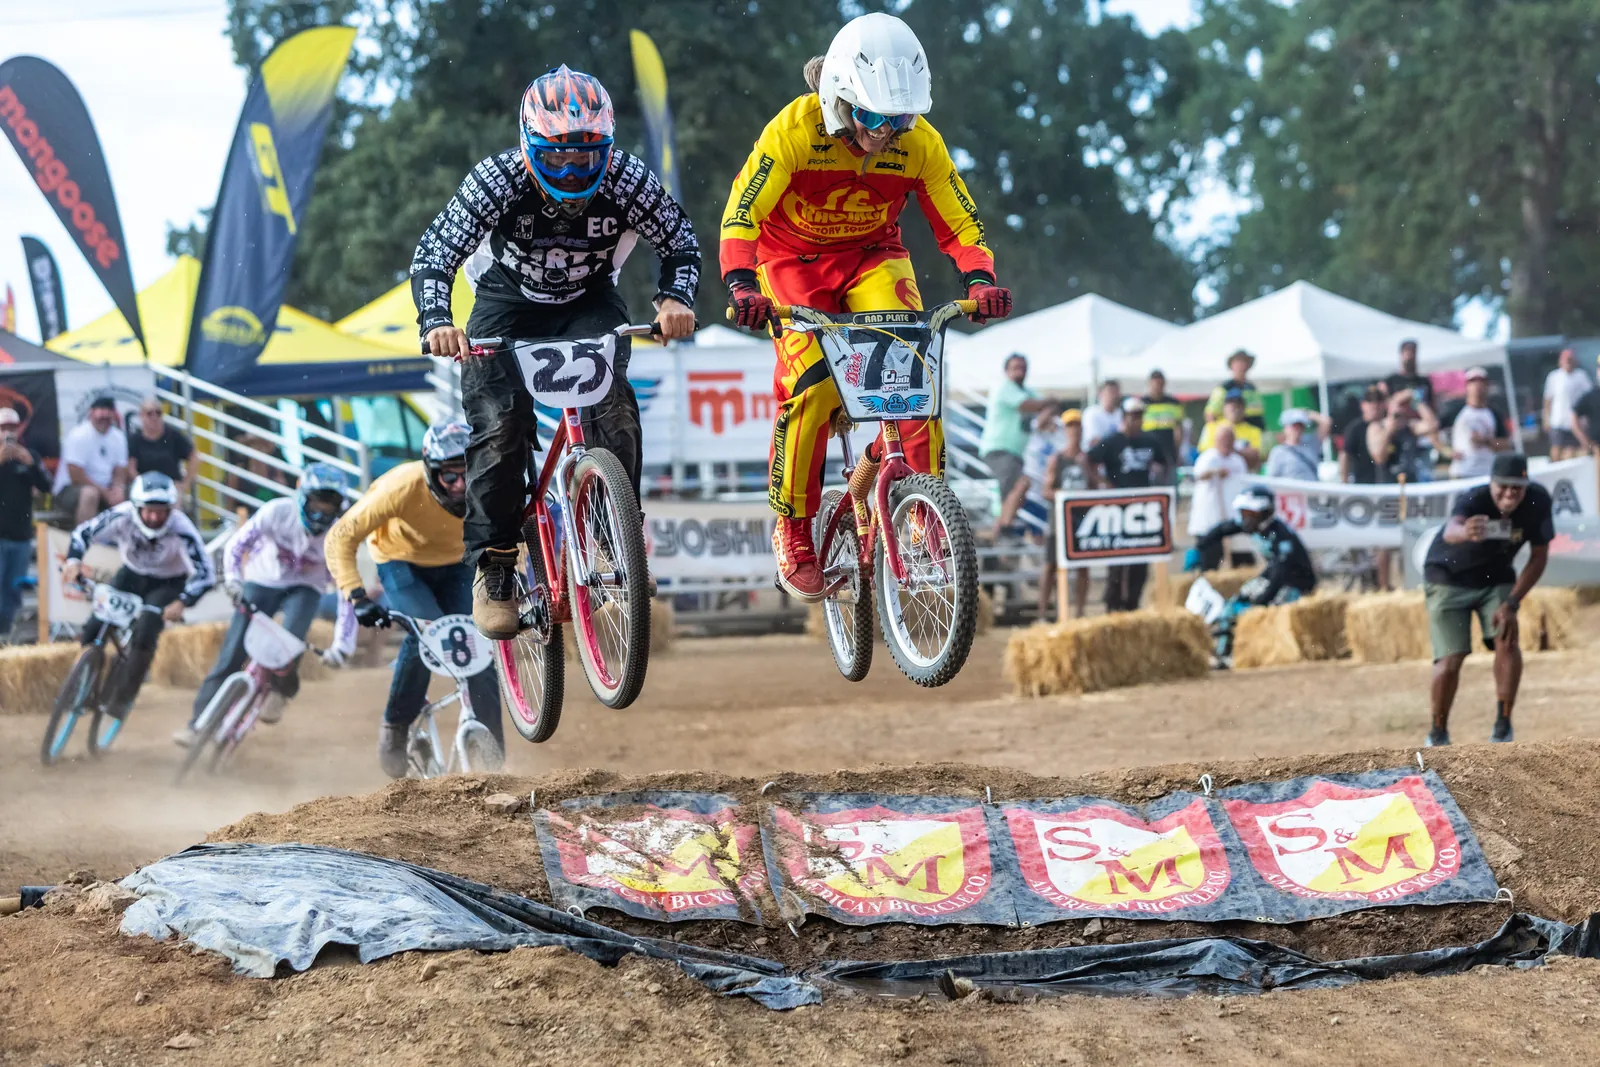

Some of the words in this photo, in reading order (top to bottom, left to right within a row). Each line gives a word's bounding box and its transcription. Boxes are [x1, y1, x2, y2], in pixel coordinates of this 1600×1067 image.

[0, 86, 120, 269] mongoose
[587, 216, 618, 238] EC
[798, 221, 841, 235] FACTORY
[844, 223, 877, 234] SQUAD
[864, 315, 884, 323] RAD
[886, 314, 909, 322] PLATE
[530, 343, 607, 395] 25
[847, 326, 933, 390] 77
[1076, 501, 1163, 537] MCS
[652, 519, 776, 558] YOSHI
[449, 626, 471, 667] 8
[889, 894, 974, 916] BICYCLE
[1138, 886, 1216, 912] BICYCLE
